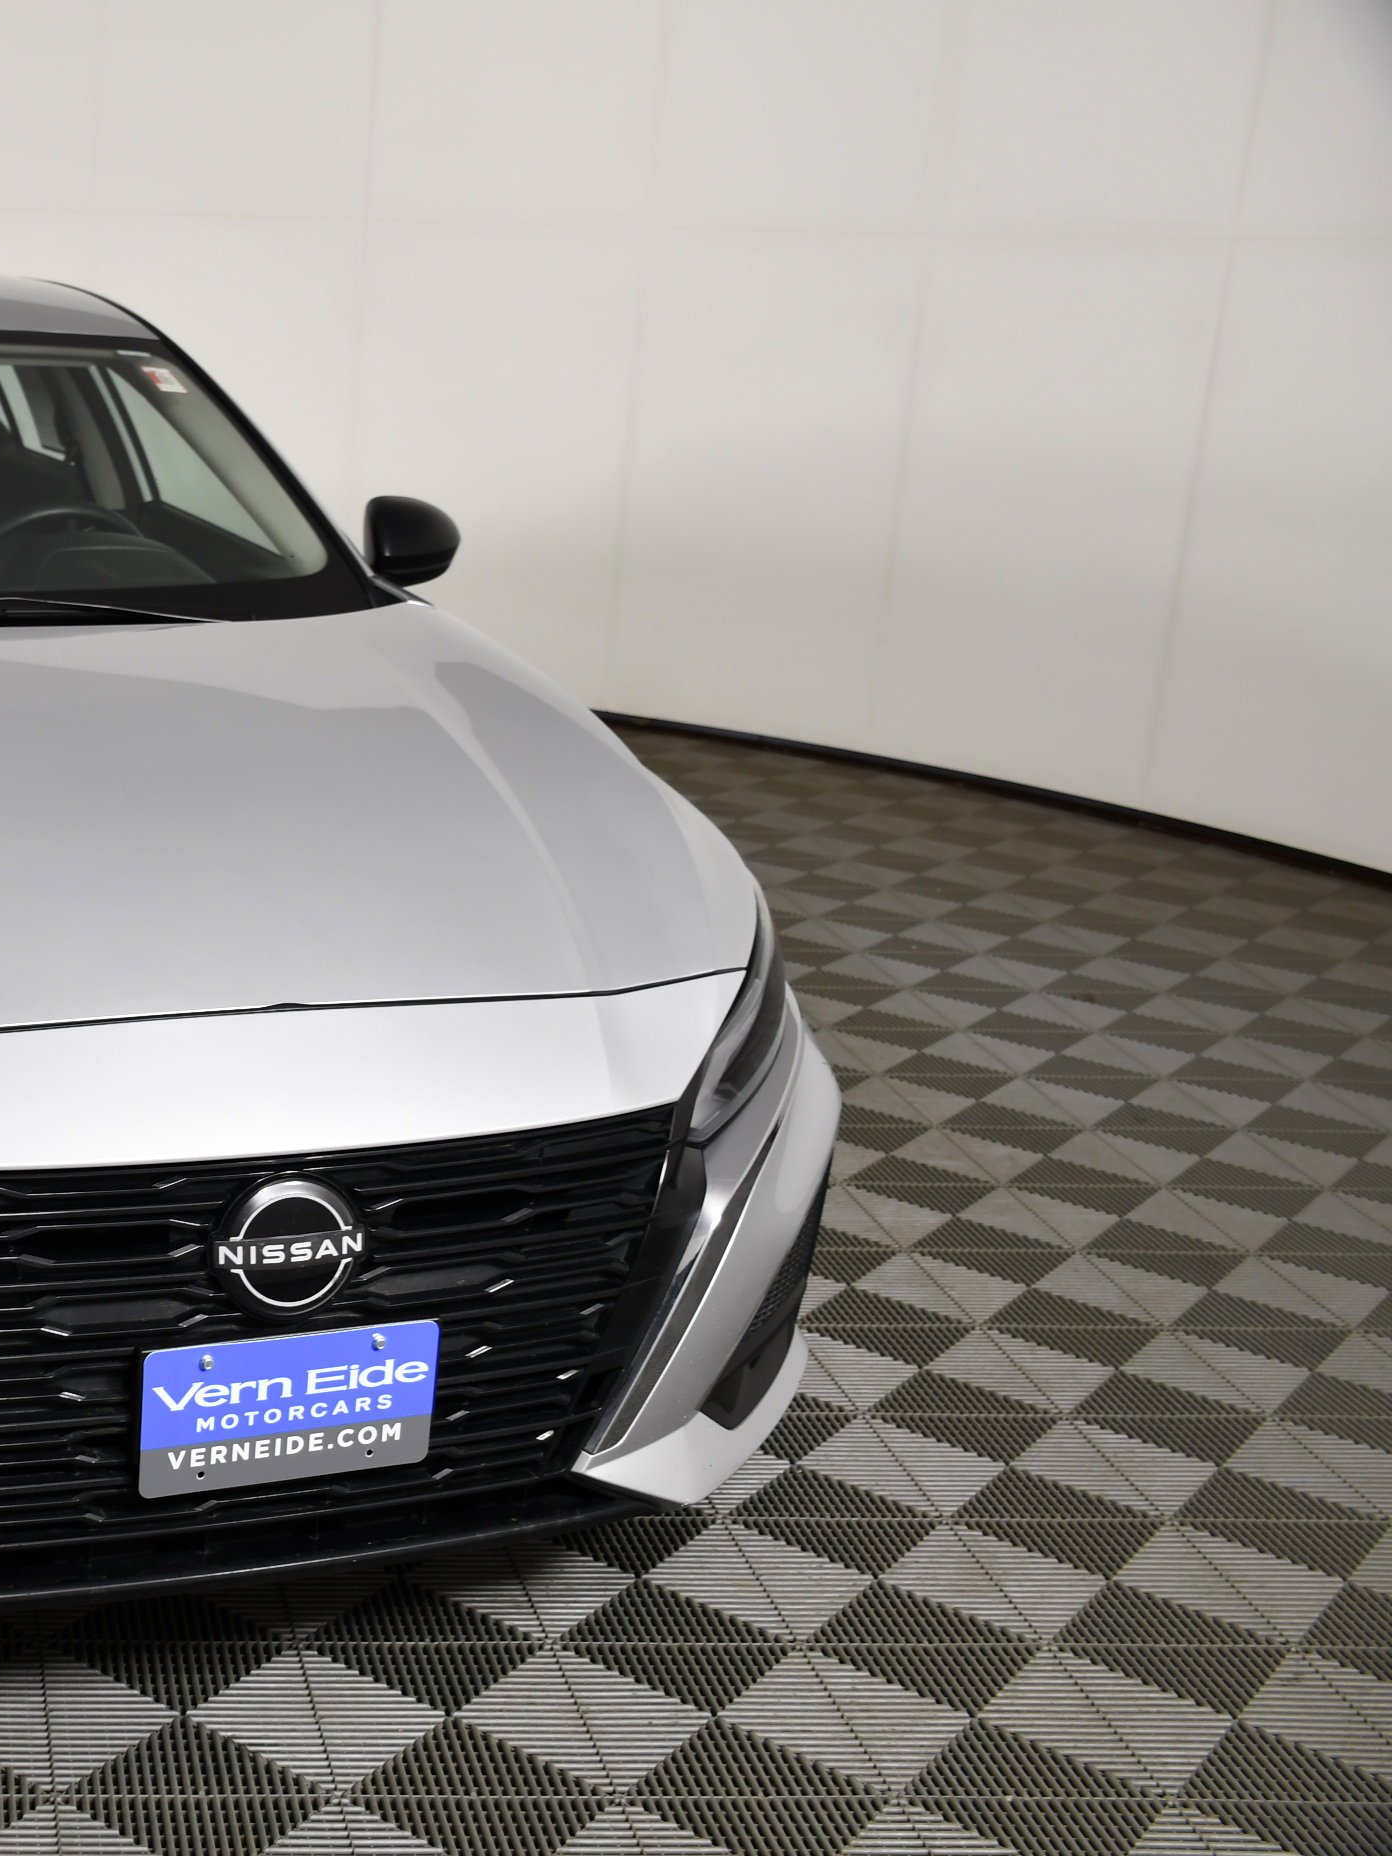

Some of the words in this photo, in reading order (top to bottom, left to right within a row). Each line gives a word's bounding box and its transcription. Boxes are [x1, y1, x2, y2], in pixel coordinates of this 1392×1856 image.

[218, 1233, 362, 1265] NISSAN
[152, 1376, 293, 1412] Vern
[305, 1359, 429, 1395] Eide
[196, 1394, 393, 1433] MOTORCARS
[168, 1422, 402, 1470] VERNEIDE.COM
